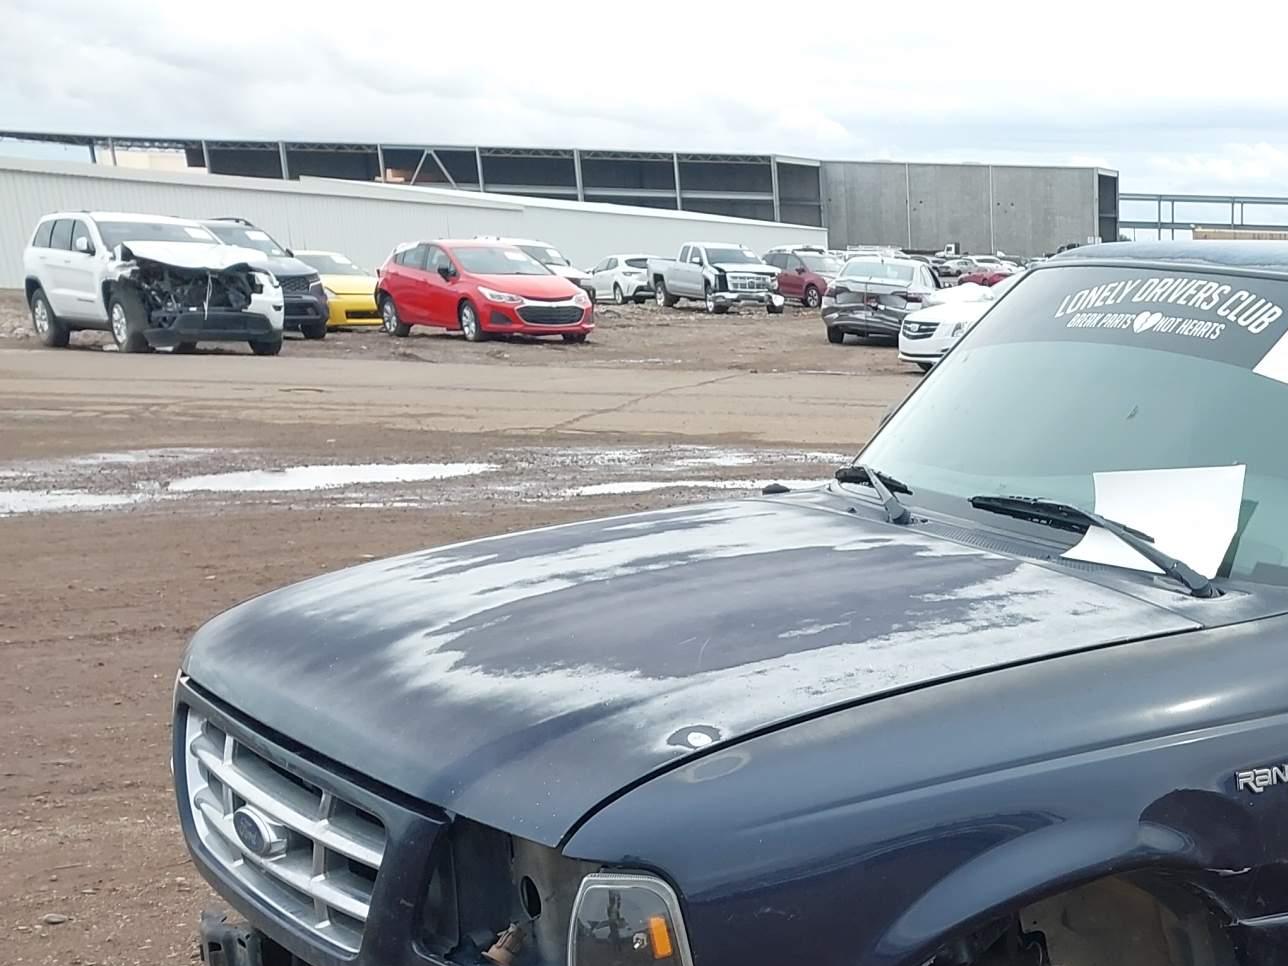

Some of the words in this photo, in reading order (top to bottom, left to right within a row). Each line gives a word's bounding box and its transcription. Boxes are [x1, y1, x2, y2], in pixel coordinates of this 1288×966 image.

[1055, 279, 1141, 318] LONELY
[1132, 277, 1232, 310] DRIVERS
[1216, 290, 1283, 334] CLUB
[1066, 312, 1102, 328] BREAK
[1097, 313, 1136, 329] PARTS
[1152, 316, 1184, 334] NOT
[1175, 319, 1225, 340] HEARTS
